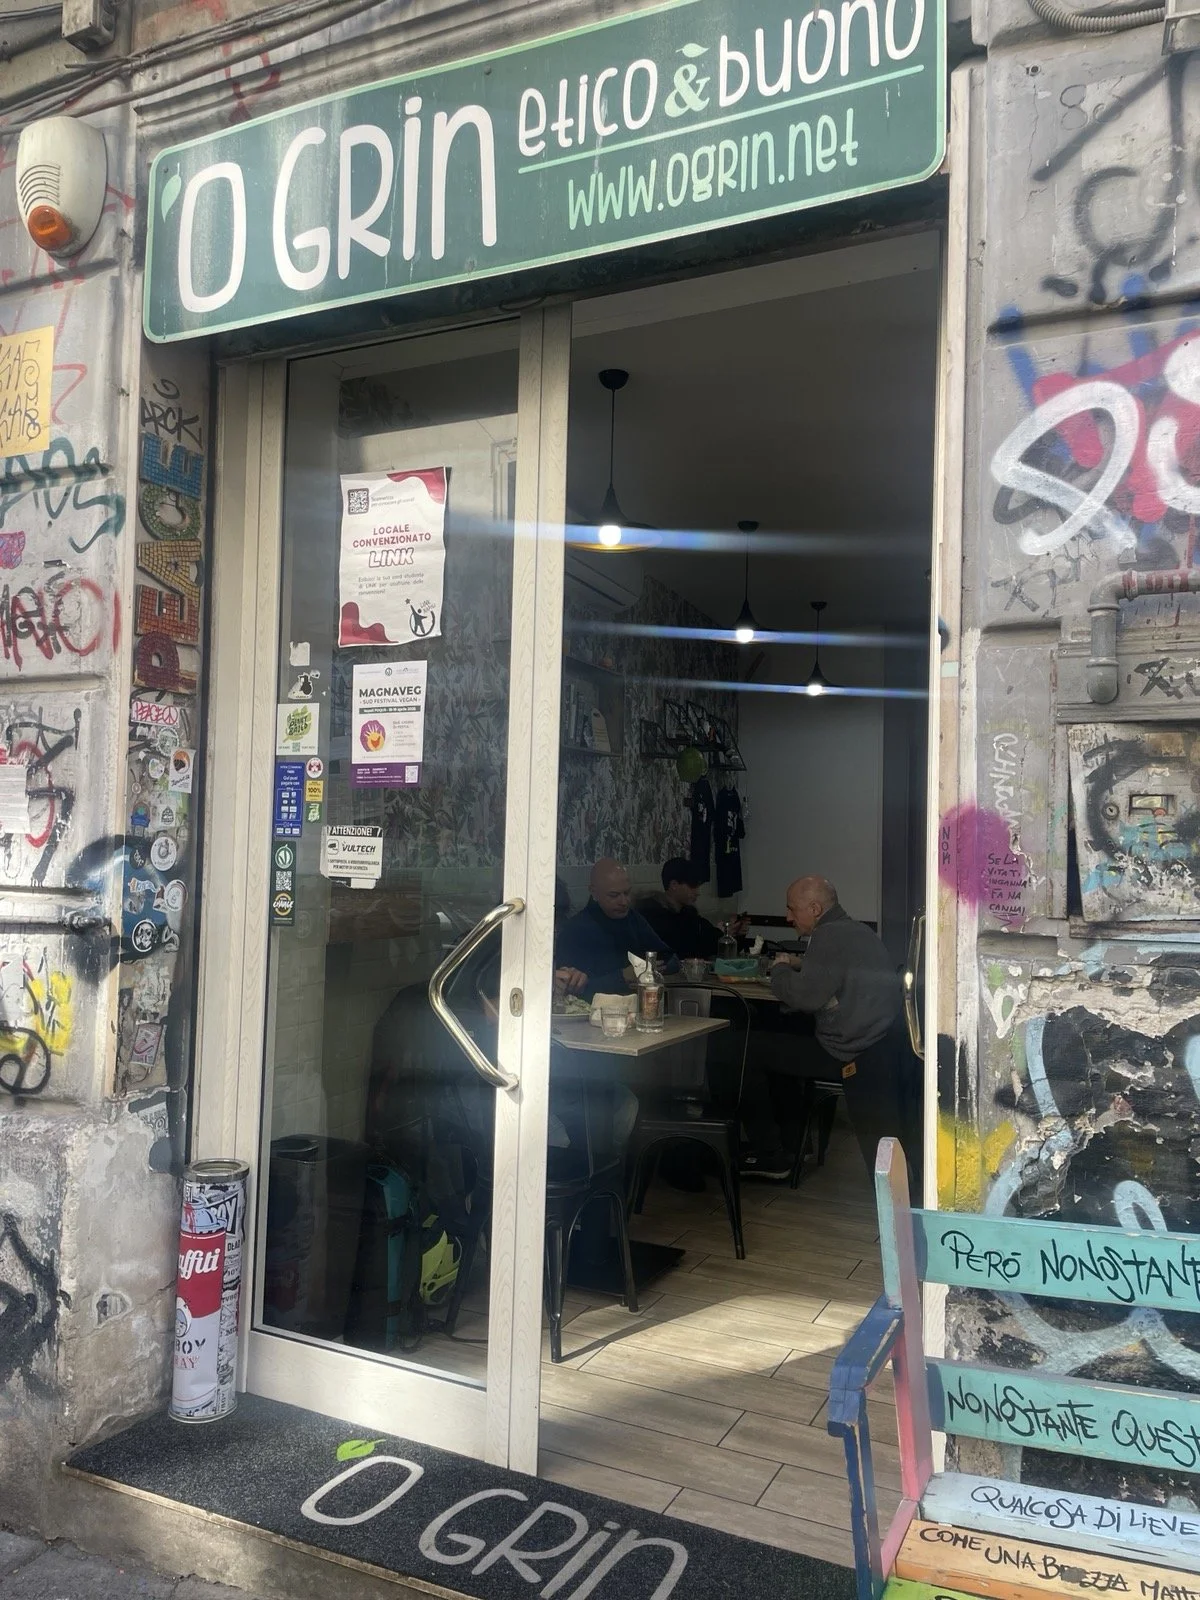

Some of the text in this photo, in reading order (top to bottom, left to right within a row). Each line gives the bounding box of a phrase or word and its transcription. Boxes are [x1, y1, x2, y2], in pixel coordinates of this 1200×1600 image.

[518, 0, 925, 156] etico & buono
[373, 523, 410, 536] LOCALE
[352, 532, 432, 548] CONVENZIONATO
[368, 547, 415, 568] LINK
[359, 686, 422, 698] MAGNAVEG
[331, 826, 373, 837] ATTENZIONE!
[342, 845, 377, 853] VULTECH
[948, 1376, 1099, 1446] NONOSTANTE
[971, 1485, 1087, 1529] QUALCOSA
[920, 1527, 985, 1550] COME
[985, 1546, 1037, 1572] UNA
